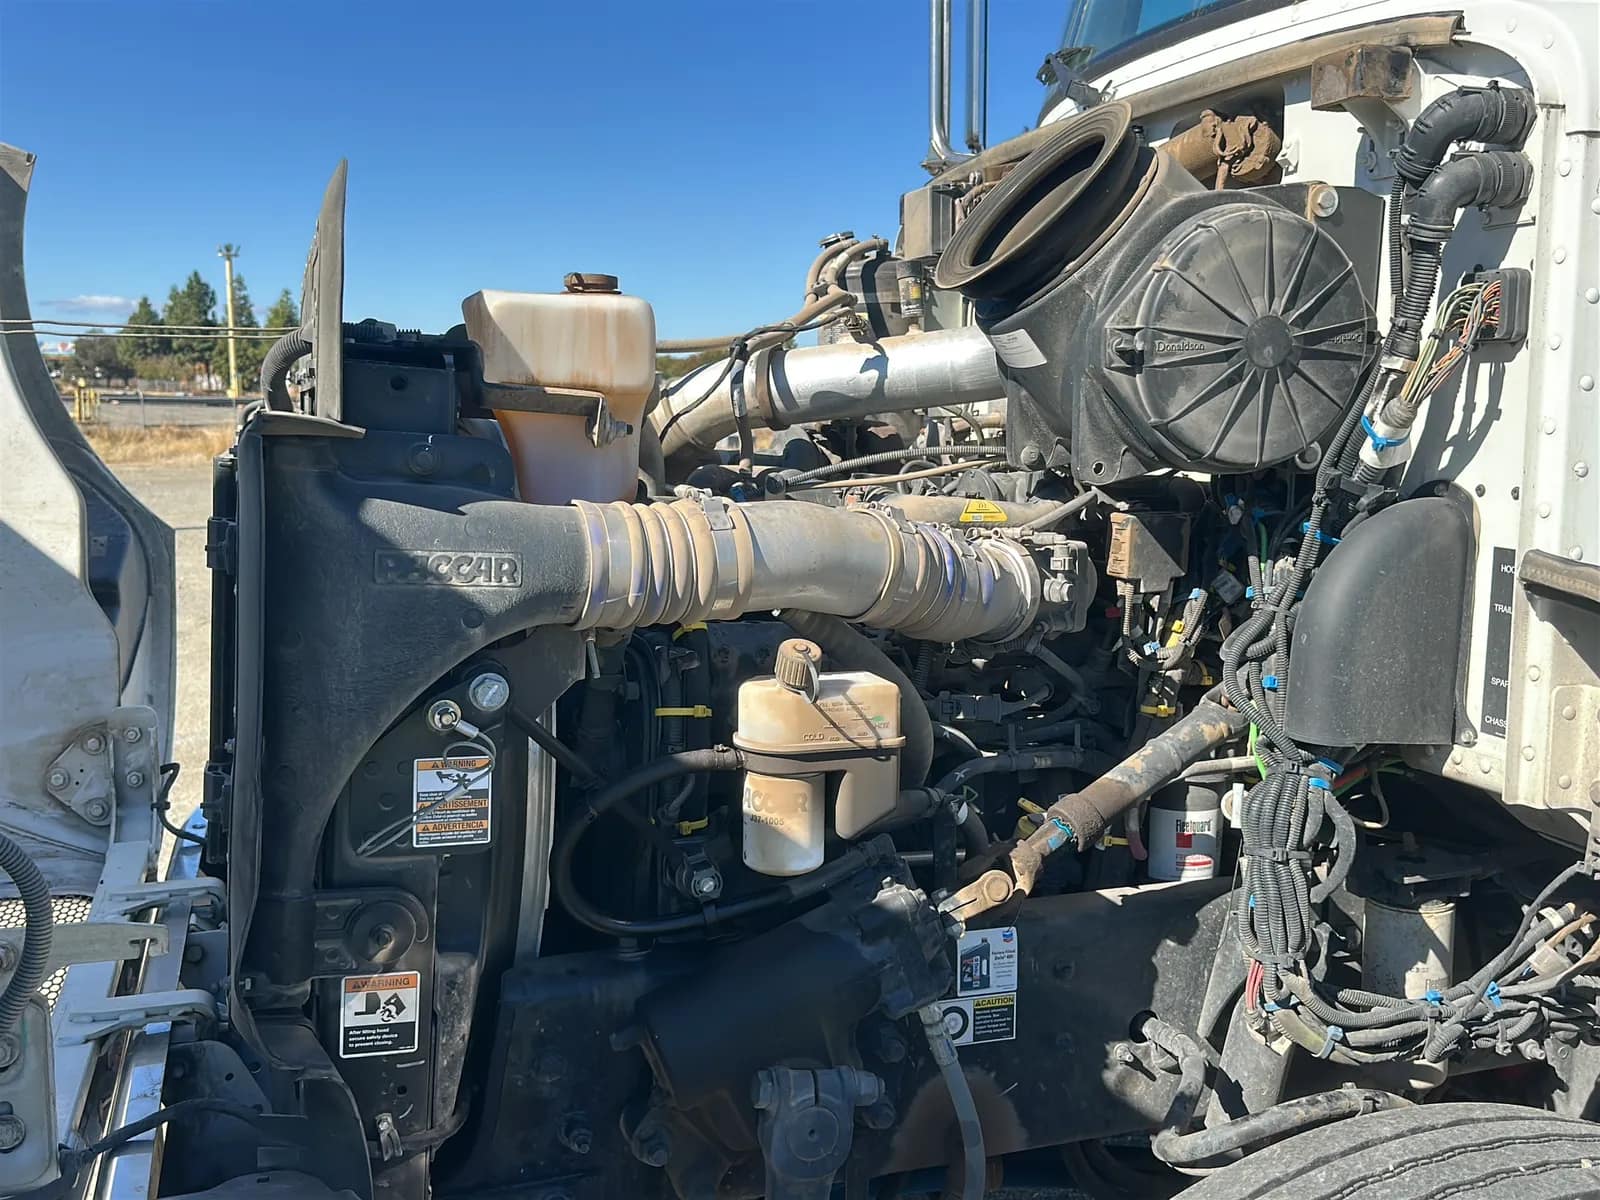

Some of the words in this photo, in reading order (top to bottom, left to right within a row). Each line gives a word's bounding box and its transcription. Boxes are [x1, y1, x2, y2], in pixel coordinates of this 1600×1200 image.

[1156, 340, 1205, 352] Donaldson
[803, 733, 824, 742] COLD
[436, 799, 487, 809] ERTISSEMENT
[744, 787, 808, 813] ACCR
[432, 822, 484, 831] ADVERTENCIA
[1176, 819, 1213, 833] Fleetguard
[360, 977, 410, 989] WARNING
[981, 996, 1014, 1007] CAUTION
